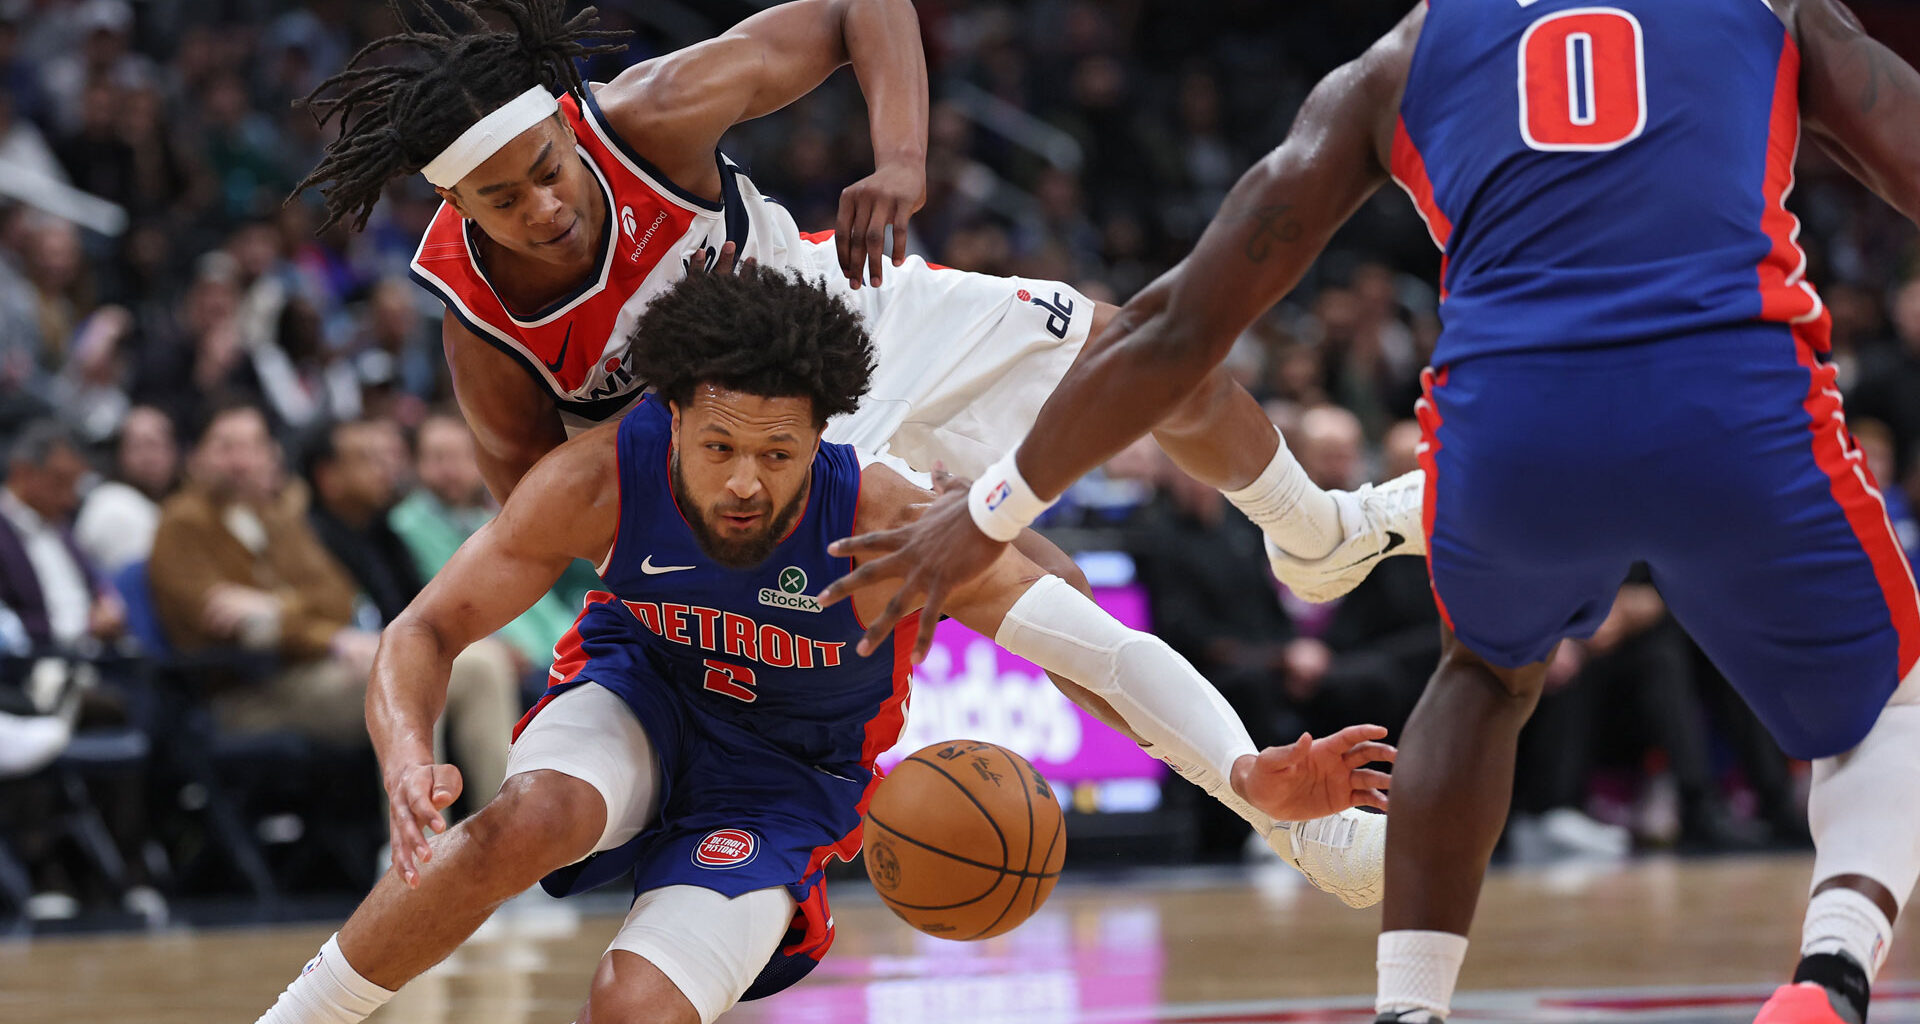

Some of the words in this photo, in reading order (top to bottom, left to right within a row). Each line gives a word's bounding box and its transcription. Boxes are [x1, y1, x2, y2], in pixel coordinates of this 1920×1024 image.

[1517, 7, 1647, 152] 0
[630, 210, 668, 263] Robinhood
[760, 590, 821, 611] StockX
[621, 600, 847, 669] DETROIT
[703, 658, 757, 703] 2
[704, 844, 741, 857] PISTONS
[710, 836, 747, 850] DETROIT
